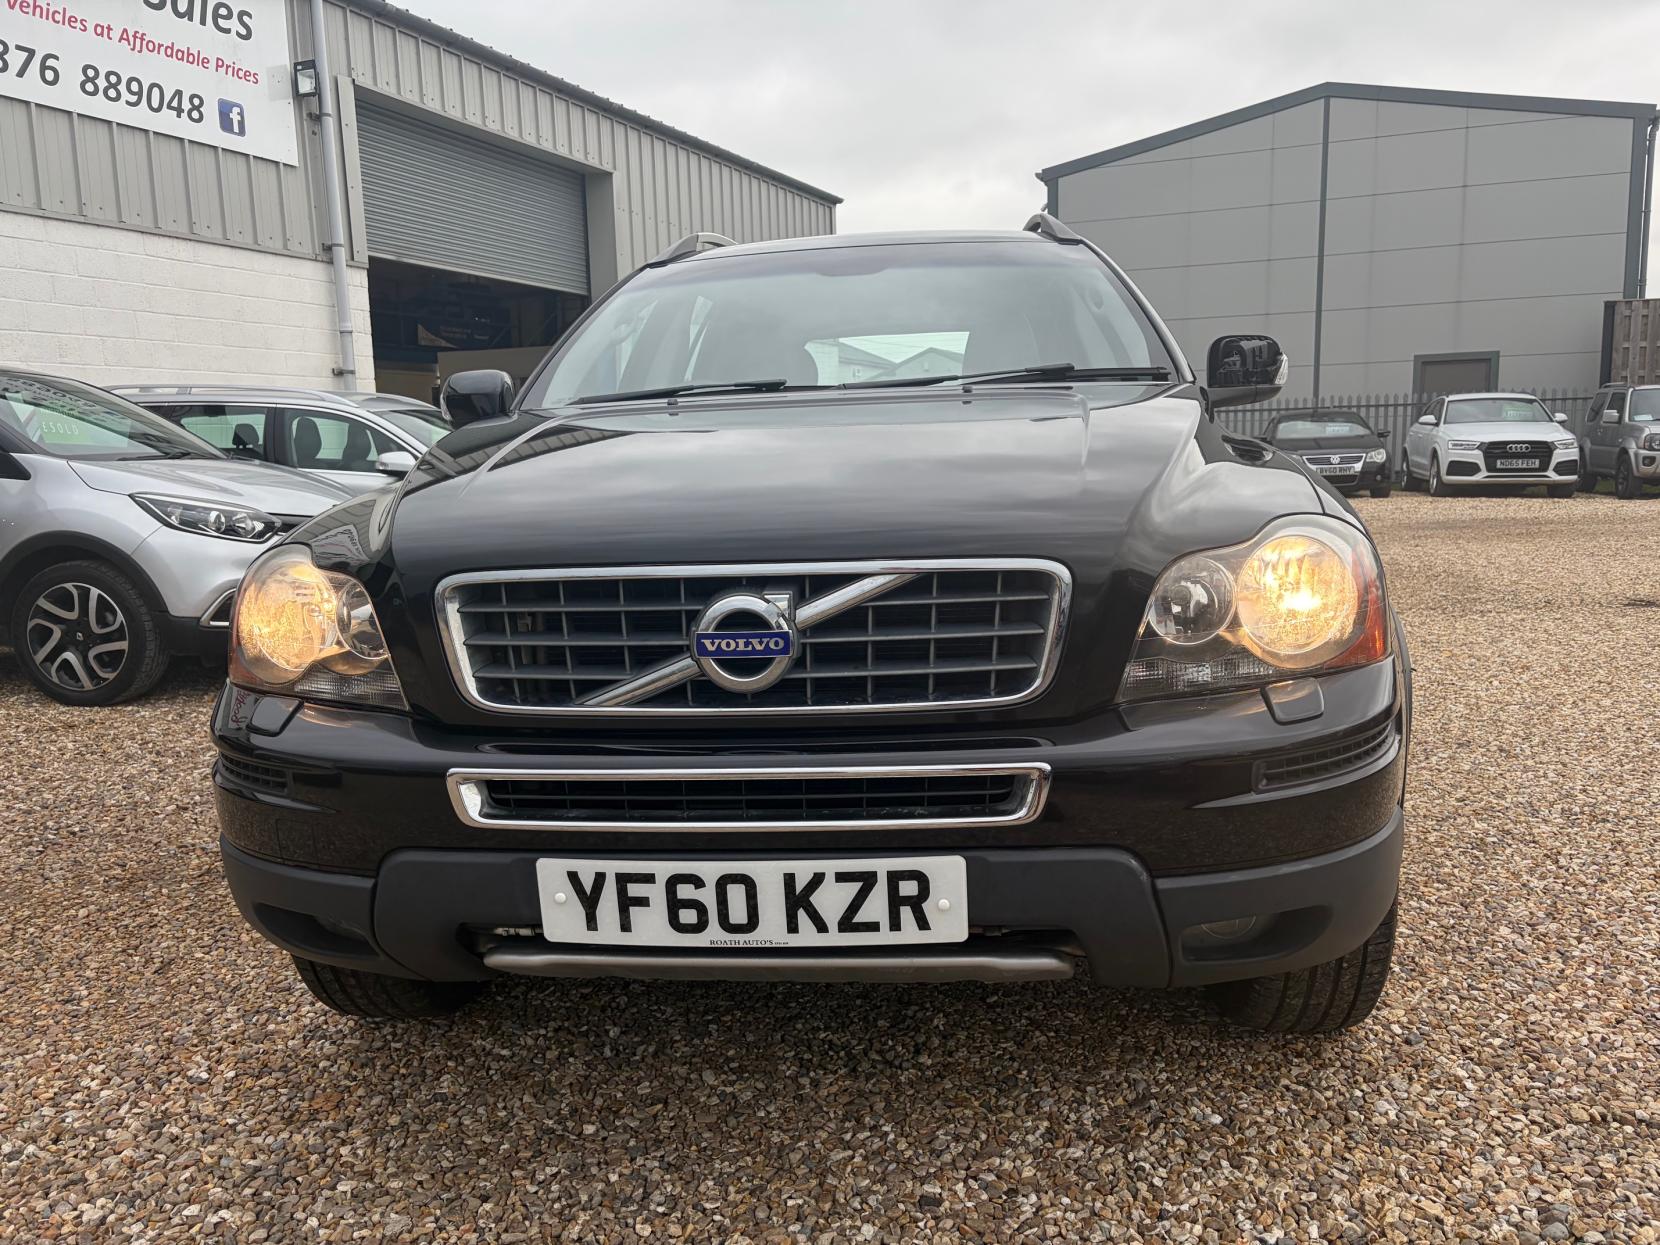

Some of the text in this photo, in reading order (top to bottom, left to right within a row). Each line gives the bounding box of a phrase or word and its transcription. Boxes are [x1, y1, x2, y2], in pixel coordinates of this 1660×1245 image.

[142, 0, 253, 41] ales
[93, 22, 114, 41] at
[118, 27, 211, 70] Affordable
[215, 56, 259, 85] Prices
[79, 63, 205, 124] 889048
[701, 637, 785, 651] VOLVO
[566, 869, 932, 935] YF60 KZR
